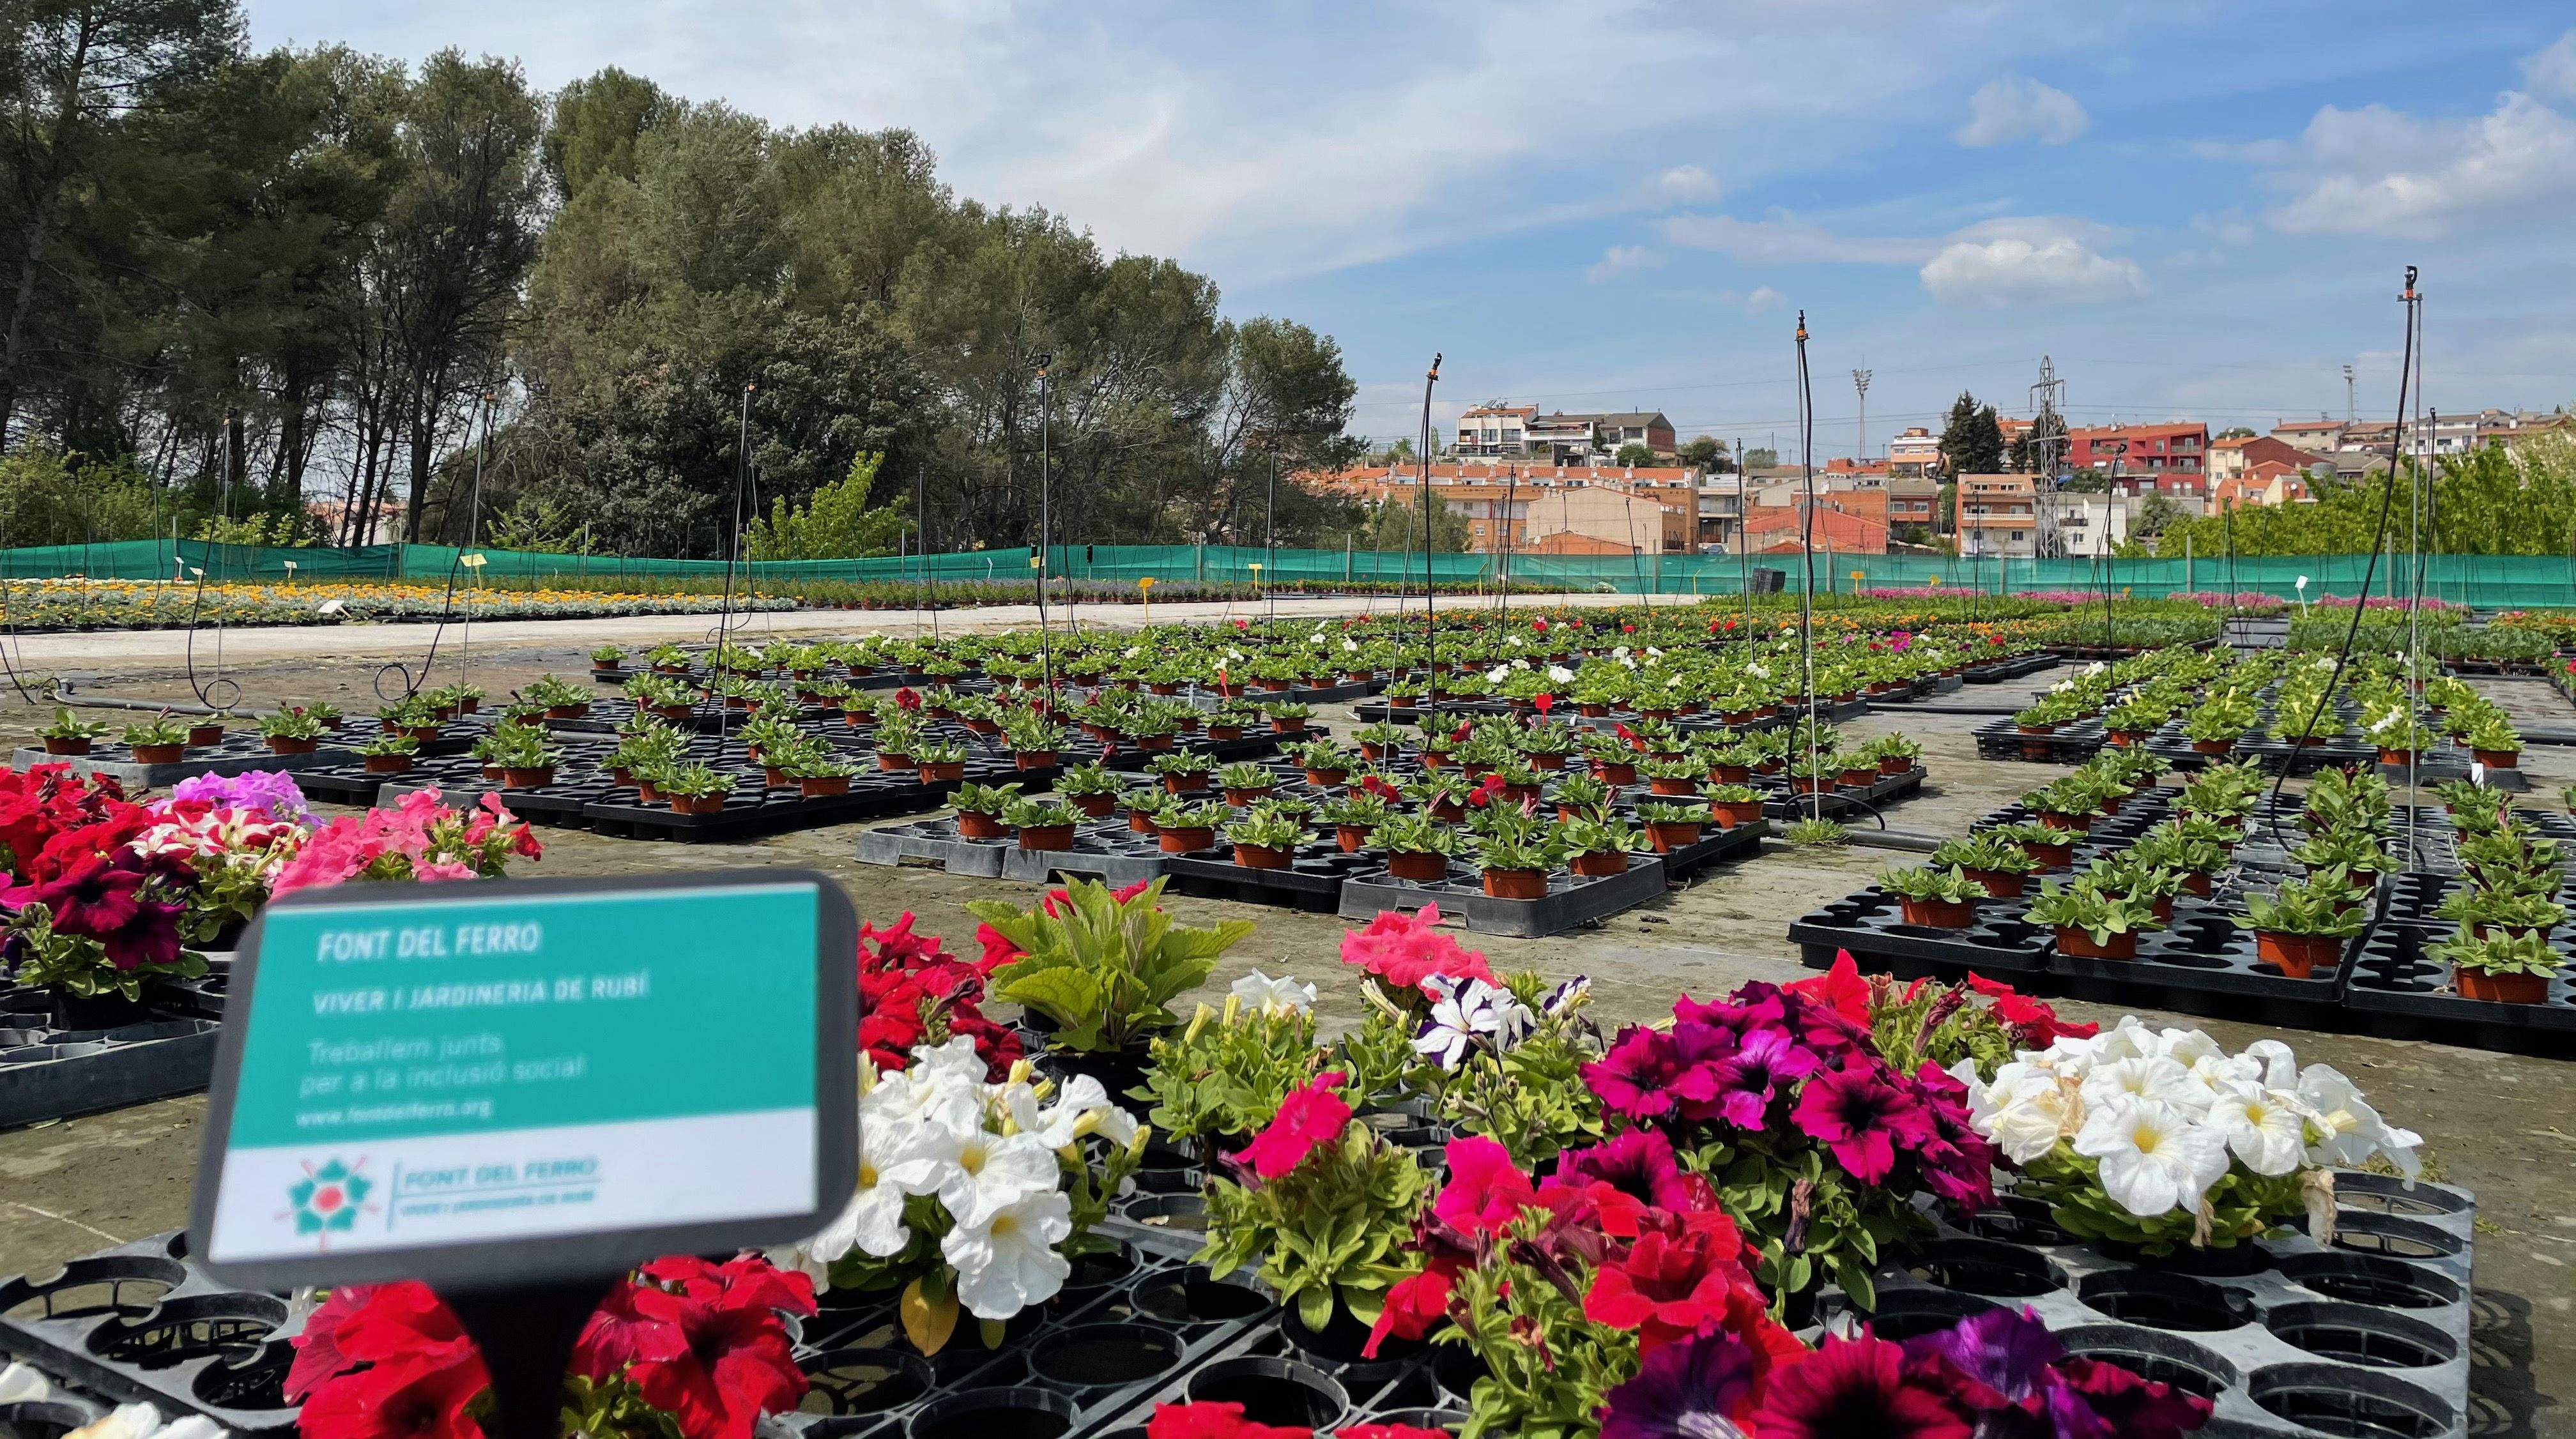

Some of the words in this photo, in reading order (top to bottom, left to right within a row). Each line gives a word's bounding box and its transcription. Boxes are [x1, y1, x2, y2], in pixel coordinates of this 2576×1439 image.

[317, 929, 390, 961] FONT
[397, 927, 447, 958] DEL
[456, 921, 542, 956] FERRO
[313, 990, 385, 1015] VIVER
[393, 987, 402, 1010] I
[408, 980, 546, 1009] JARDINERIA
[554, 977, 582, 1001] DE
[592, 968, 650, 999] RUBÍ
[307, 1038, 431, 1065] Treballem
[438, 1033, 503, 1061] junts
[299, 1076, 342, 1099] per
[351, 1074, 366, 1091] a
[374, 1069, 398, 1090] la
[406, 1060, 506, 1086] inclusió
[512, 1053, 584, 1081] social
[404, 1168, 469, 1188] FONT
[475, 1165, 516, 1183] DEL
[524, 1158, 599, 1179] FERRO
